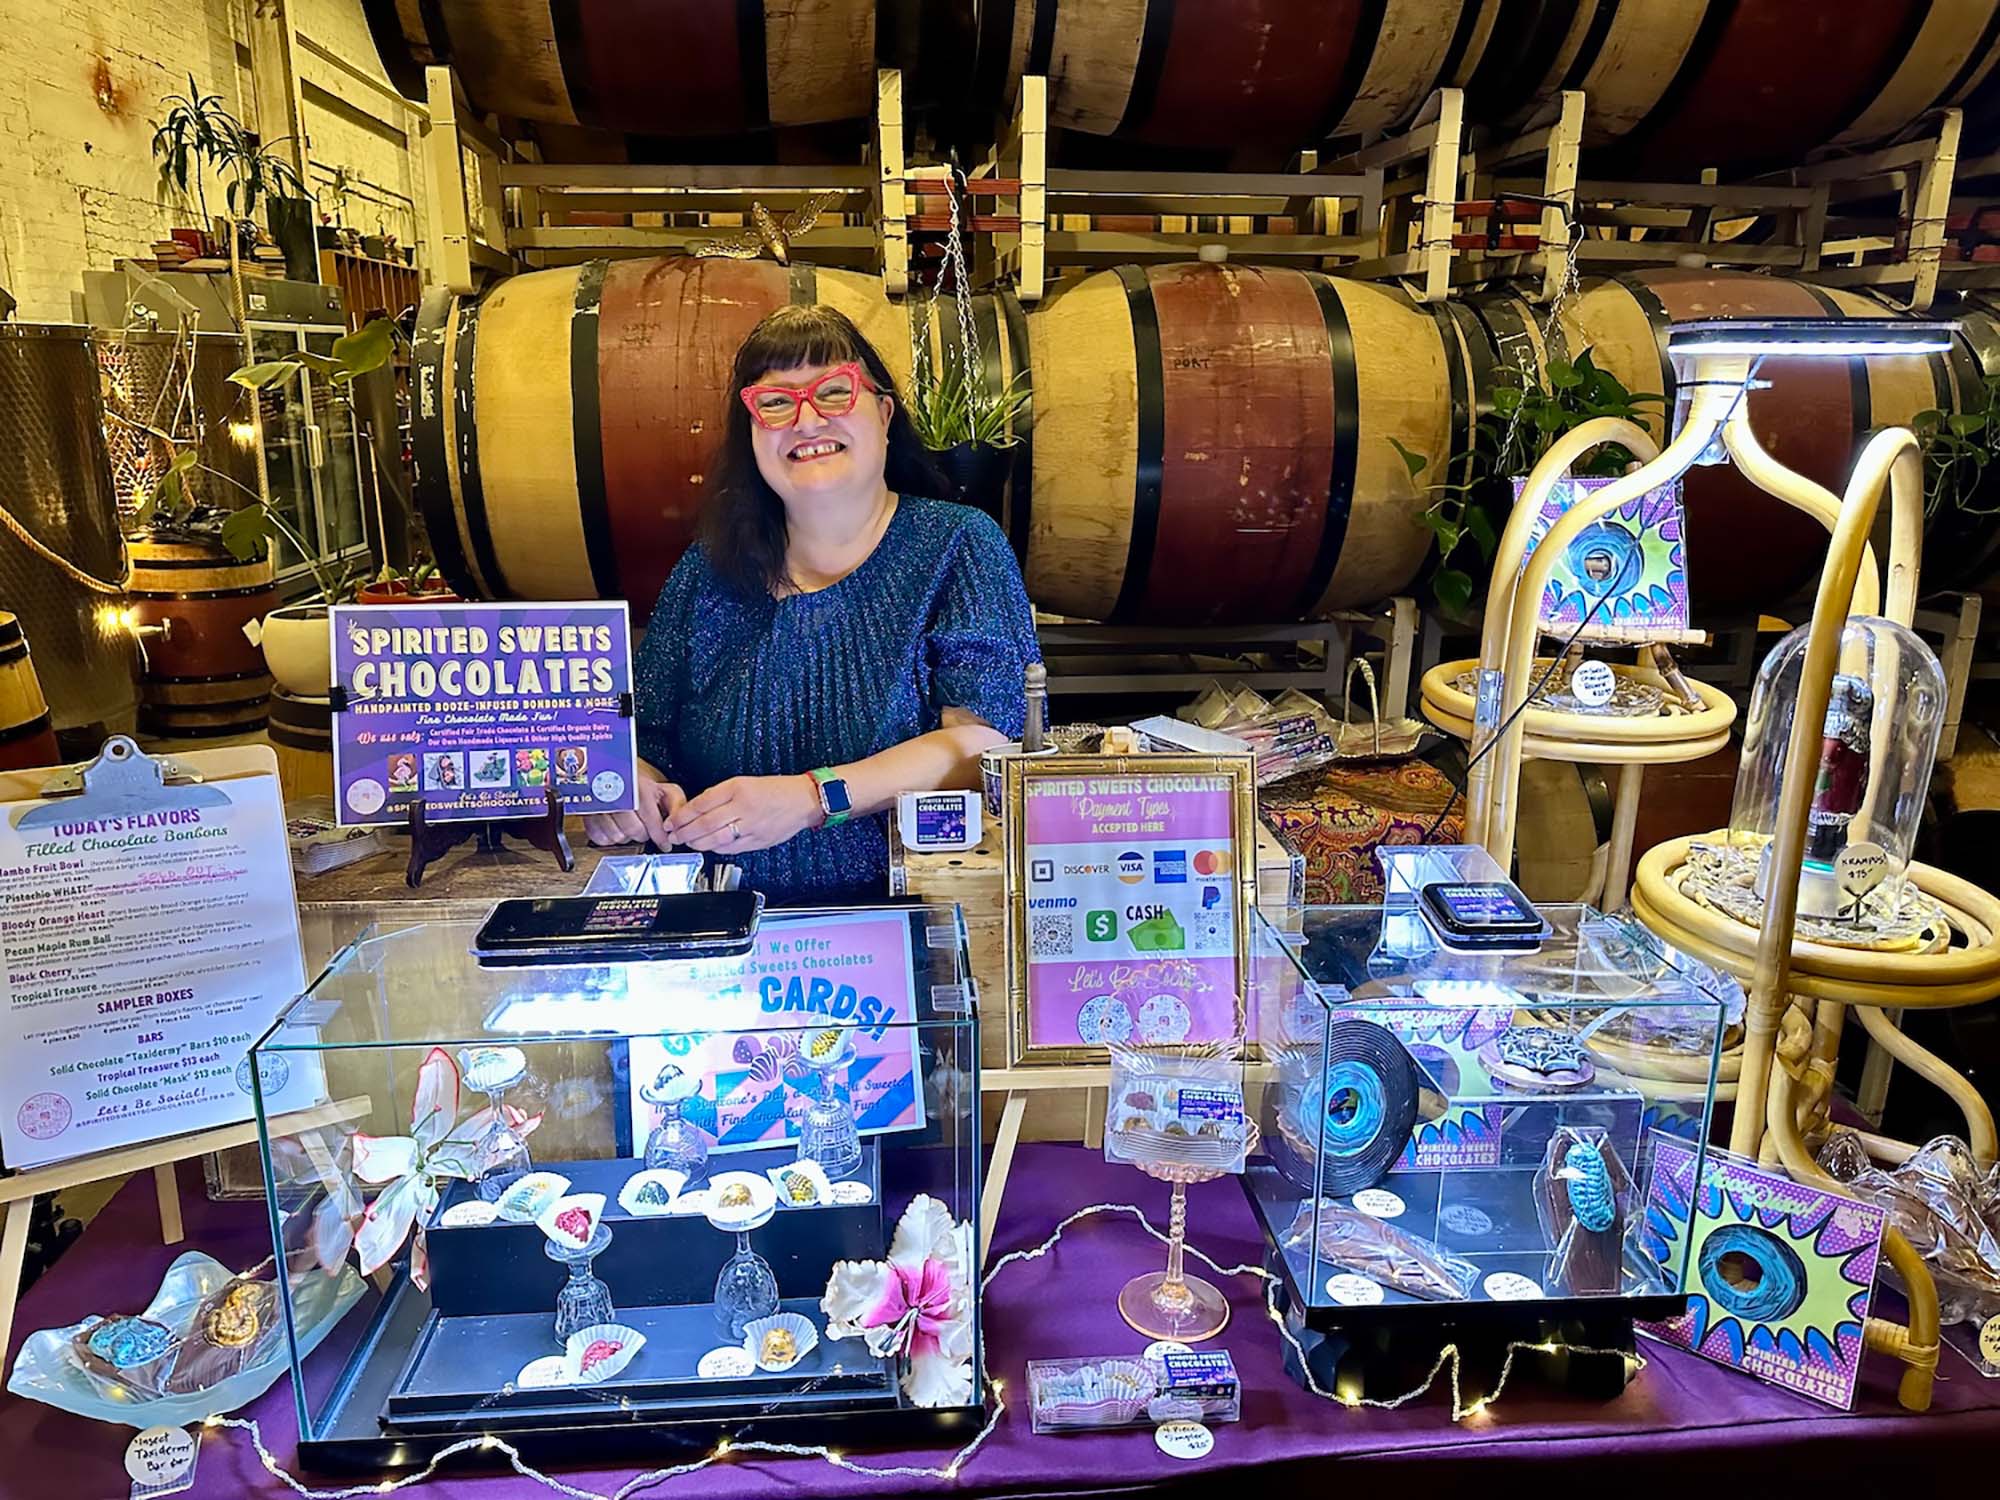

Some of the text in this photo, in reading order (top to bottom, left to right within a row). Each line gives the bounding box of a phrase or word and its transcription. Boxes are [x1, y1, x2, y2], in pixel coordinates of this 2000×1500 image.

[1174, 357, 1210, 369] PORT
[353, 626, 612, 656] SPIRITED SWEETS
[352, 657, 613, 698] CHOCOLATES
[355, 698, 614, 714] HANDPAINTED BOOZE-INFUSED BONBONS & MORE
[416, 711, 558, 725] Fine Chocolate Made Fun!
[357, 731, 424, 744] We use only:
[427, 738, 440, 746] Our
[458, 737, 493, 746] Handmade
[494, 736, 523, 745] Liqueurs
[531, 734, 549, 742] Other
[551, 733, 566, 743] High
[568, 733, 591, 742] Quality
[592, 732, 613, 741] Spirits
[429, 728, 459, 736] Certified
[461, 727, 475, 735] Fair
[476, 726, 496, 735] Trade
[496, 725, 529, 734] Chocolate
[536, 724, 565, 733] Certified
[567, 724, 592, 733] Organic
[593, 723, 610, 733] Dairy
[1027, 776, 1233, 798] SPIRITED SWEETS CHOCOLATES
[1079, 796, 1170, 820] Payment Types
[127, 808, 201, 830] FLAVORS
[1092, 821, 1165, 834] ACCEPTED HERE
[25, 841, 76, 858] Filled
[82, 834, 159, 852] Chocolate
[164, 826, 228, 843] Bonbons
[33, 863, 57, 873] Fruit
[59, 859, 84, 870] Bowl
[137, 870, 176, 881] SOLD
[185, 864, 213, 879] OUT
[1064, 862, 1143, 874] DISCOVER VISA
[1029, 896, 1078, 910] venmo
[1126, 905, 1164, 921] CASH
[1, 909, 105, 931] Bloody Orange Heart
[4, 934, 112, 957] Pecan Maple Rum Ball
[769, 938, 832, 954] We Offer
[750, 960, 798, 974] Sweets
[802, 953, 873, 970] Chocolates
[9, 967, 72, 984] Black Cherry
[1068, 965, 1104, 992] Let's
[11, 989, 52, 1004] Tropical
[53, 983, 98, 998] Treasure
[97, 995, 154, 1015] SAMPLER
[156, 987, 194, 1005] BOXES
[759, 975, 896, 1041] CARDS!
[48, 1036, 67, 1044] piece
[138, 1031, 165, 1045] BARS
[49, 1063, 75, 1077] Solid
[76, 1055, 124, 1072] Chocolate
[189, 1041, 211, 1051] Bars
[212, 1034, 229, 1047] $10
[230, 1031, 252, 1043] each
[97, 1052, 220, 1083] Tropical Treasure $13 each
[86, 1086, 110, 1101] Solid
[112, 1081, 158, 1096] Chocolate
[193, 1069, 210, 1081] $13
[211, 1065, 233, 1077] each
[97, 1086, 206, 1117] Let's Be Social!
[721, 1111, 750, 1127] Fine
[853, 1099, 881, 1112] Fun!
[1416, 1152, 1496, 1166] CHOCOLATES
[1168, 1360, 1230, 1369] CHOCOLATES
[1744, 1345, 1847, 1389] SPIRITED SWEETS
[1741, 1355, 1846, 1404] CHOCOLATES
[146, 1459, 165, 1471] Bar
